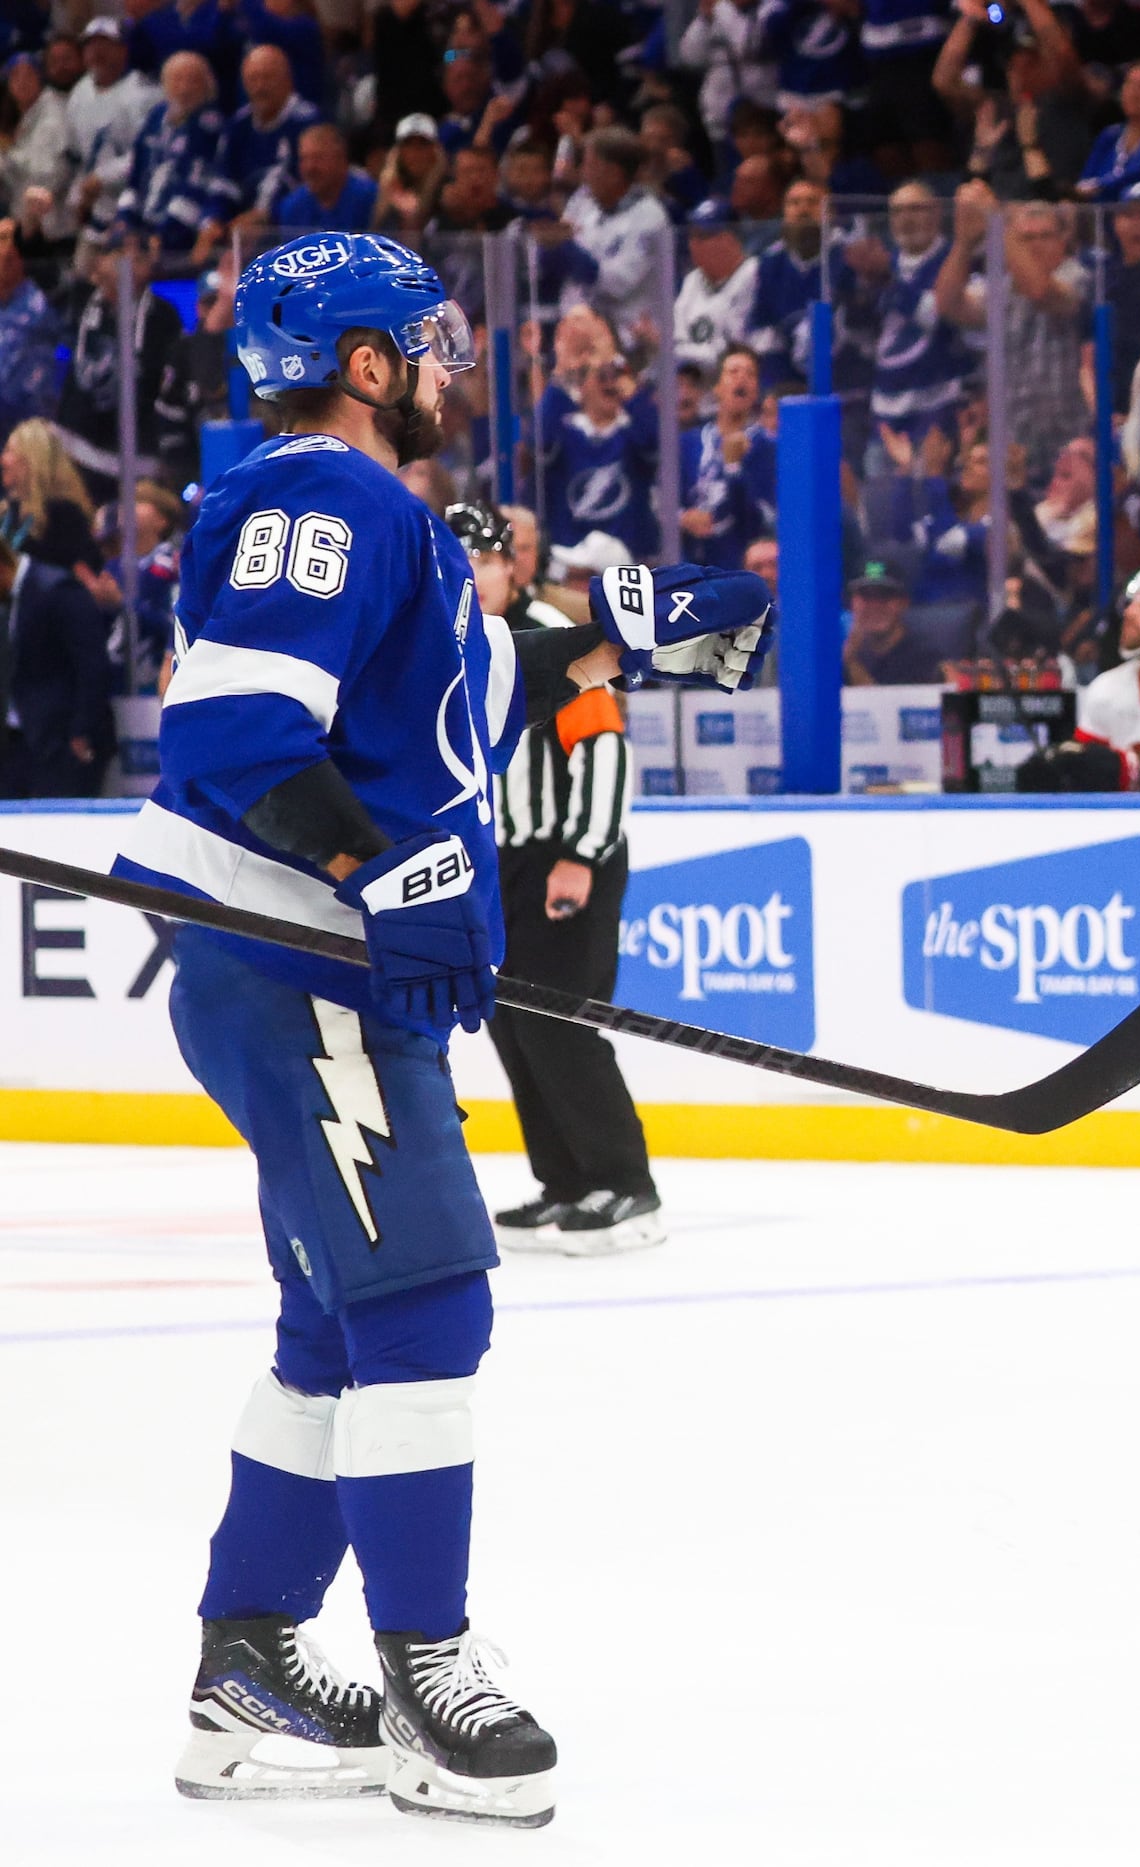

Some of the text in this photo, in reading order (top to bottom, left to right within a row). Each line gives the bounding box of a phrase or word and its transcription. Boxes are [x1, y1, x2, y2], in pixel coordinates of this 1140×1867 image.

[229, 508, 353, 600] 86
[646, 891, 795, 1001] spot
[923, 891, 1136, 1003] the spot
[222, 1679, 292, 1730] CCM
